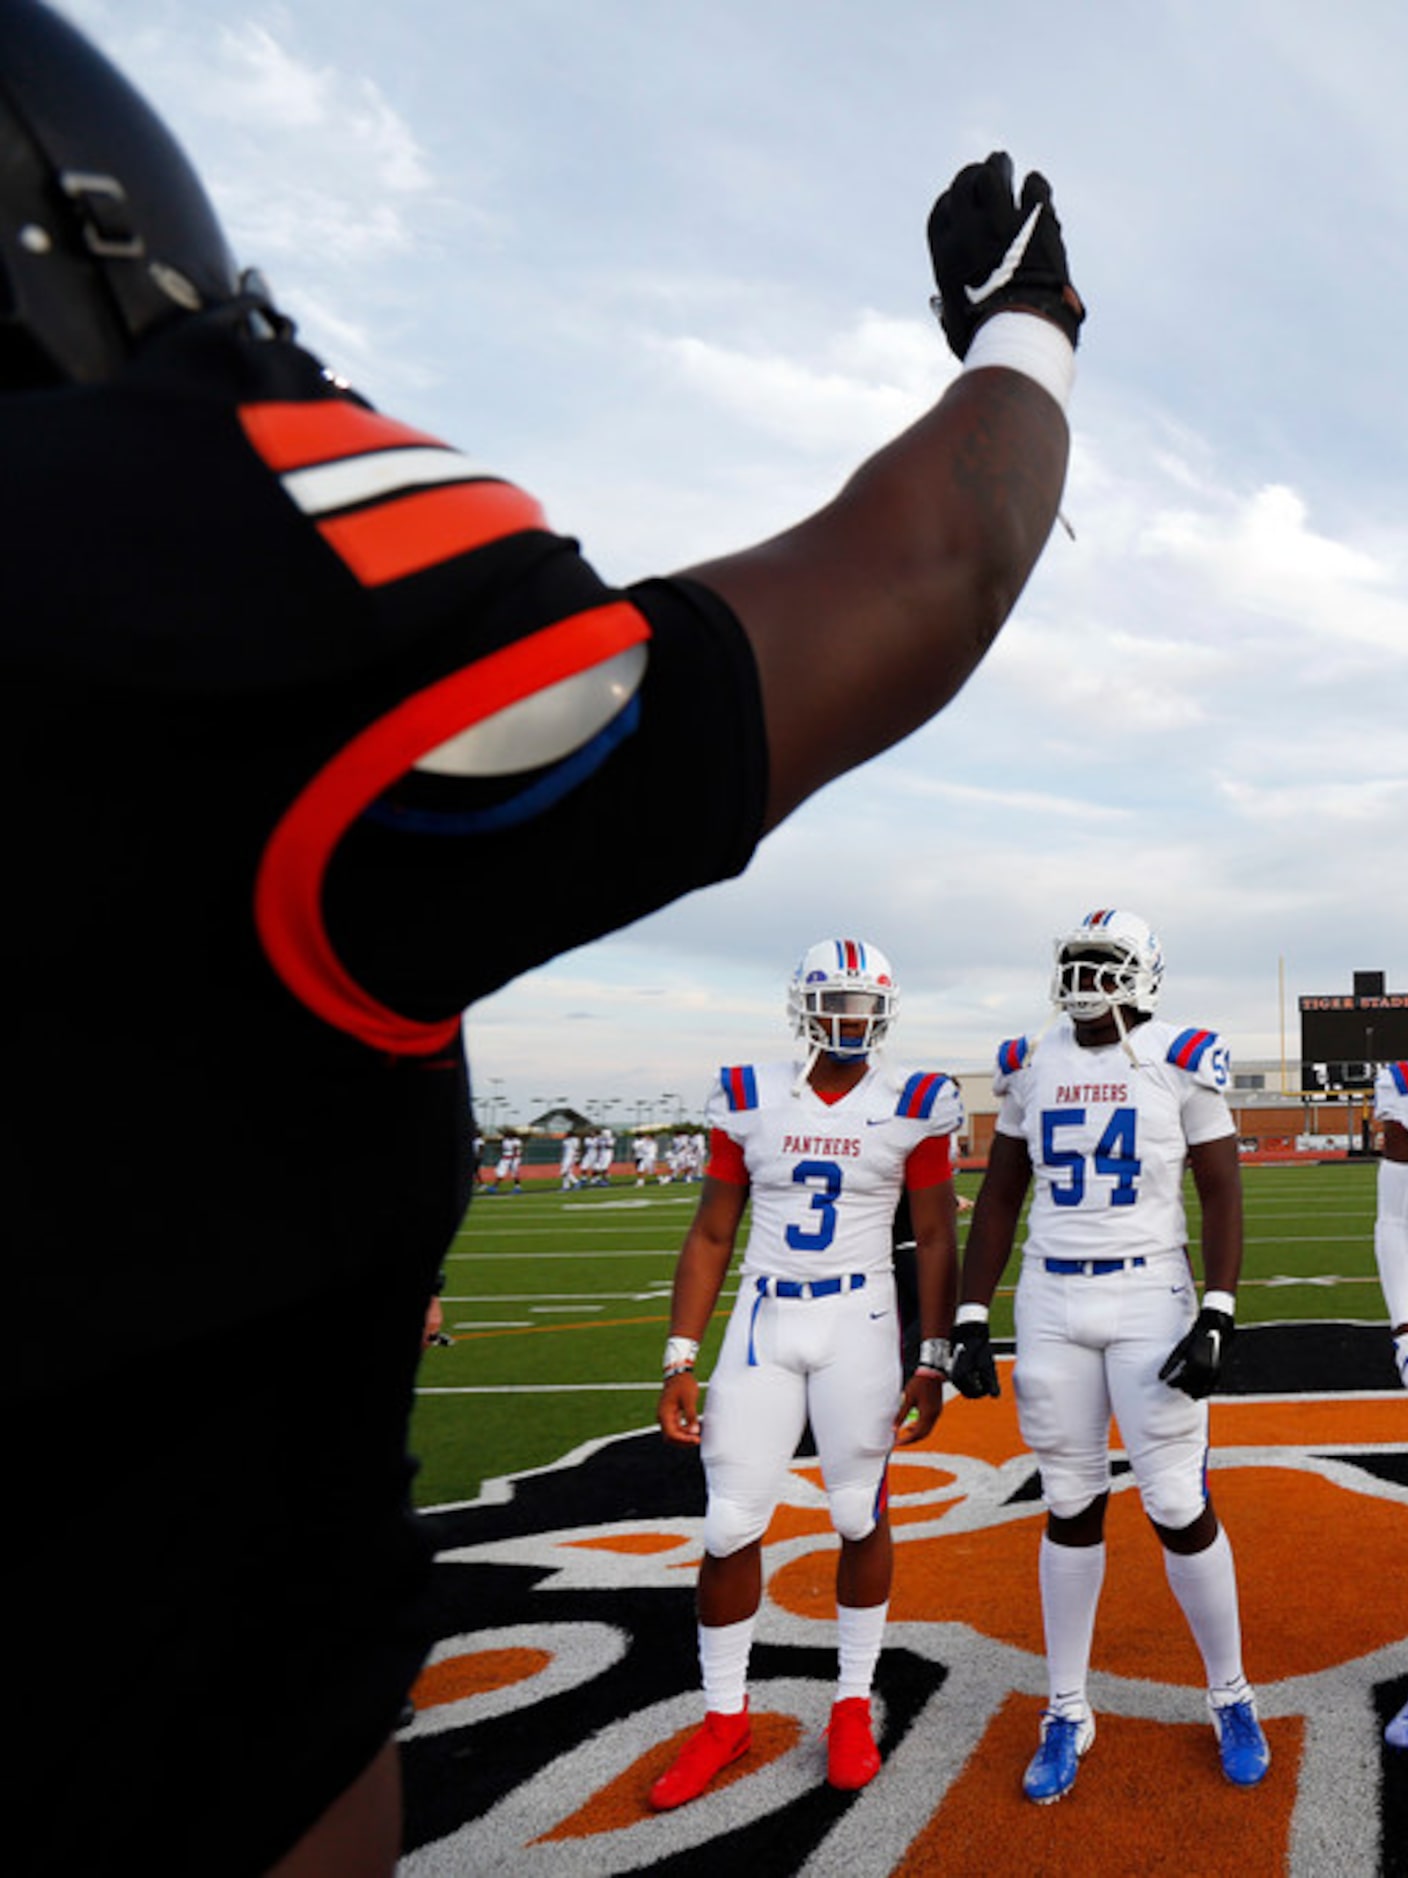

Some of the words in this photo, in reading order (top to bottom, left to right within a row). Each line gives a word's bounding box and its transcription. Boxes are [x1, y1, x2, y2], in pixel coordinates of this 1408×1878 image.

[1302, 997, 1354, 1010] TIGER
[1055, 1084, 1128, 1103] PANTHERS
[782, 1135, 861, 1157] PANTHERS
[1041, 1107, 1142, 1207] 54
[784, 1160, 844, 1251] 3
